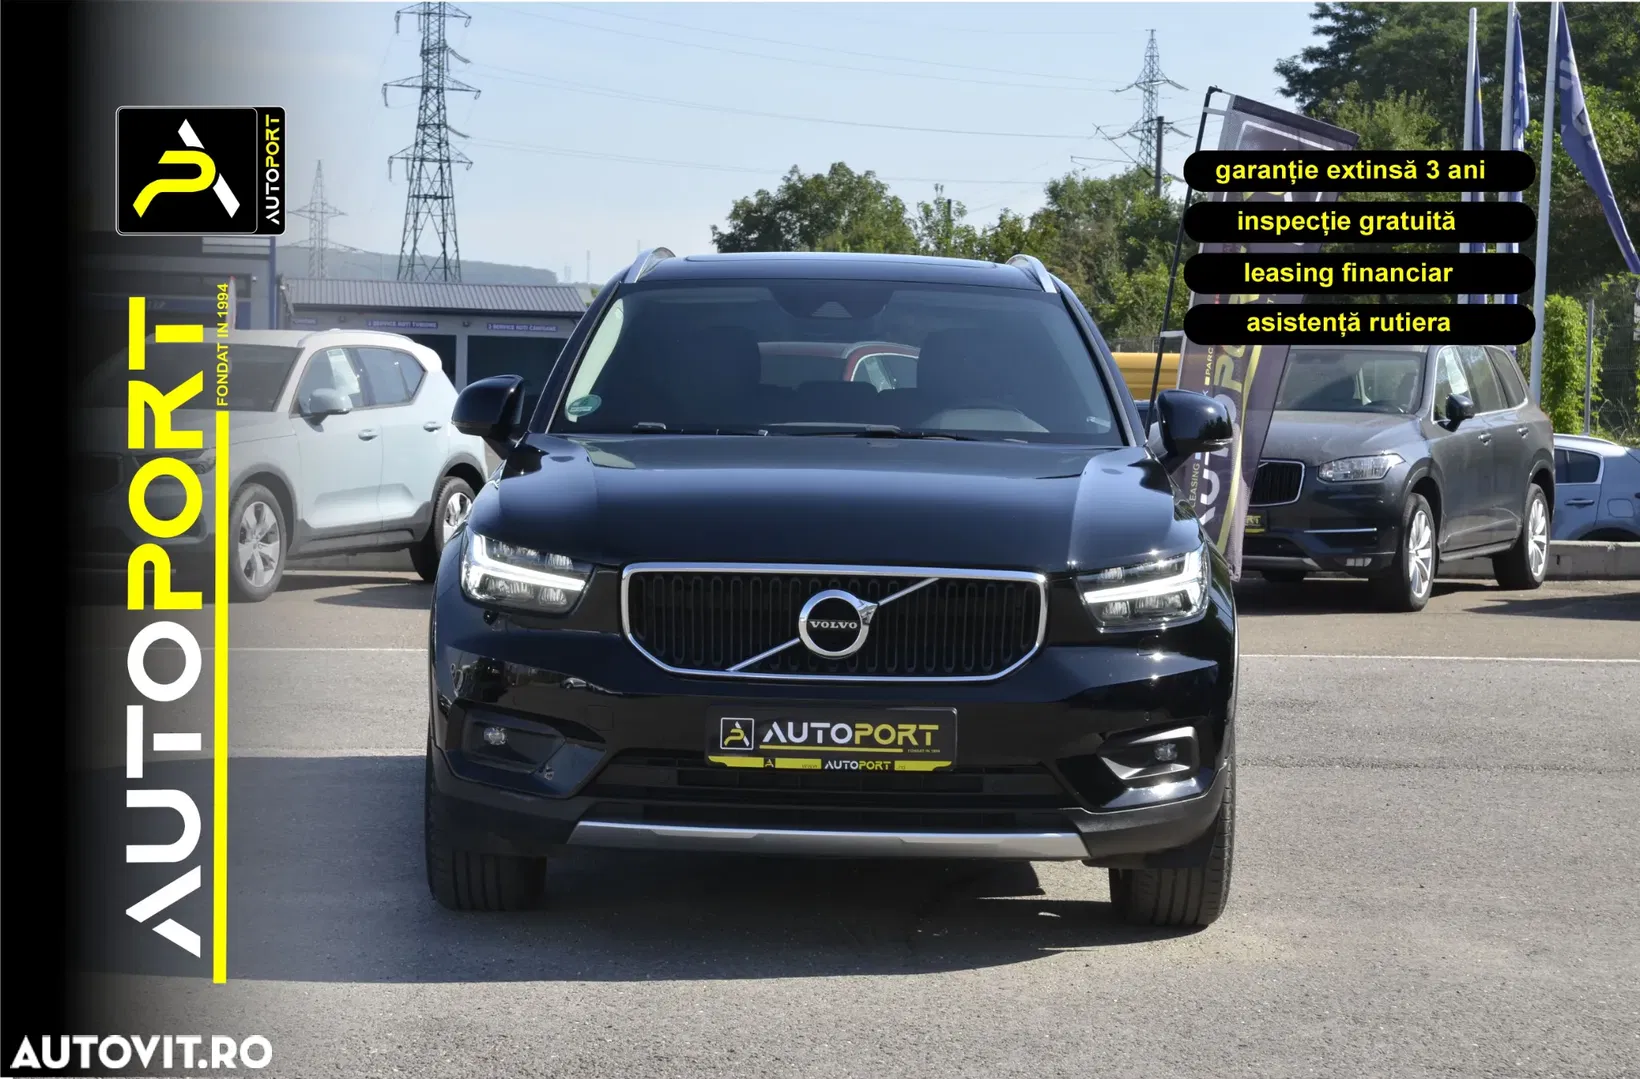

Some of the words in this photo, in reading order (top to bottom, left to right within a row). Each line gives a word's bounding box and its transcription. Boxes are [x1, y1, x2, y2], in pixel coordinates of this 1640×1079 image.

[810, 621, 858, 629] VOLVO
[762, 721, 940, 747] AUTOPORT
[824, 760, 891, 771] AUTOPORT
